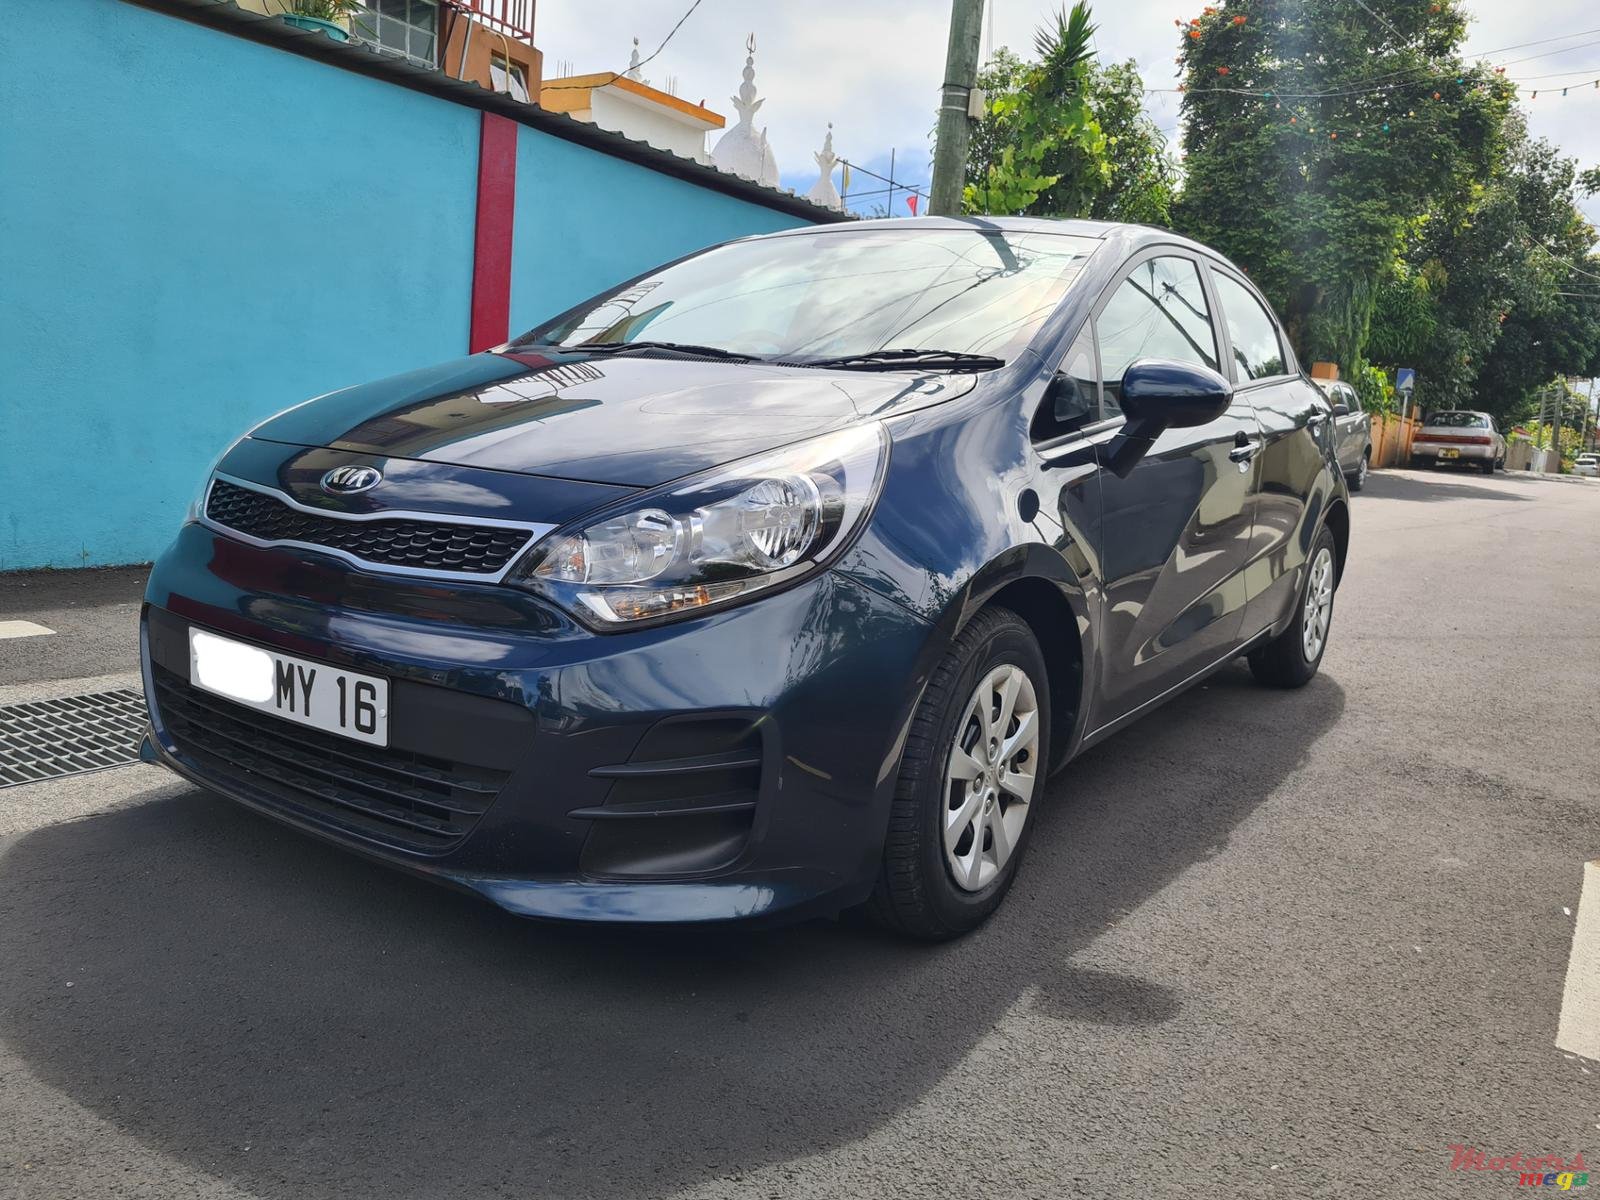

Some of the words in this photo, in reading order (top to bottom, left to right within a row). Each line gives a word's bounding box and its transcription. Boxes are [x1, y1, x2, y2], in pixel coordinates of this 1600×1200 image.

[326, 467, 370, 488] KIA
[276, 659, 316, 717] MY
[336, 676, 376, 735] 16
